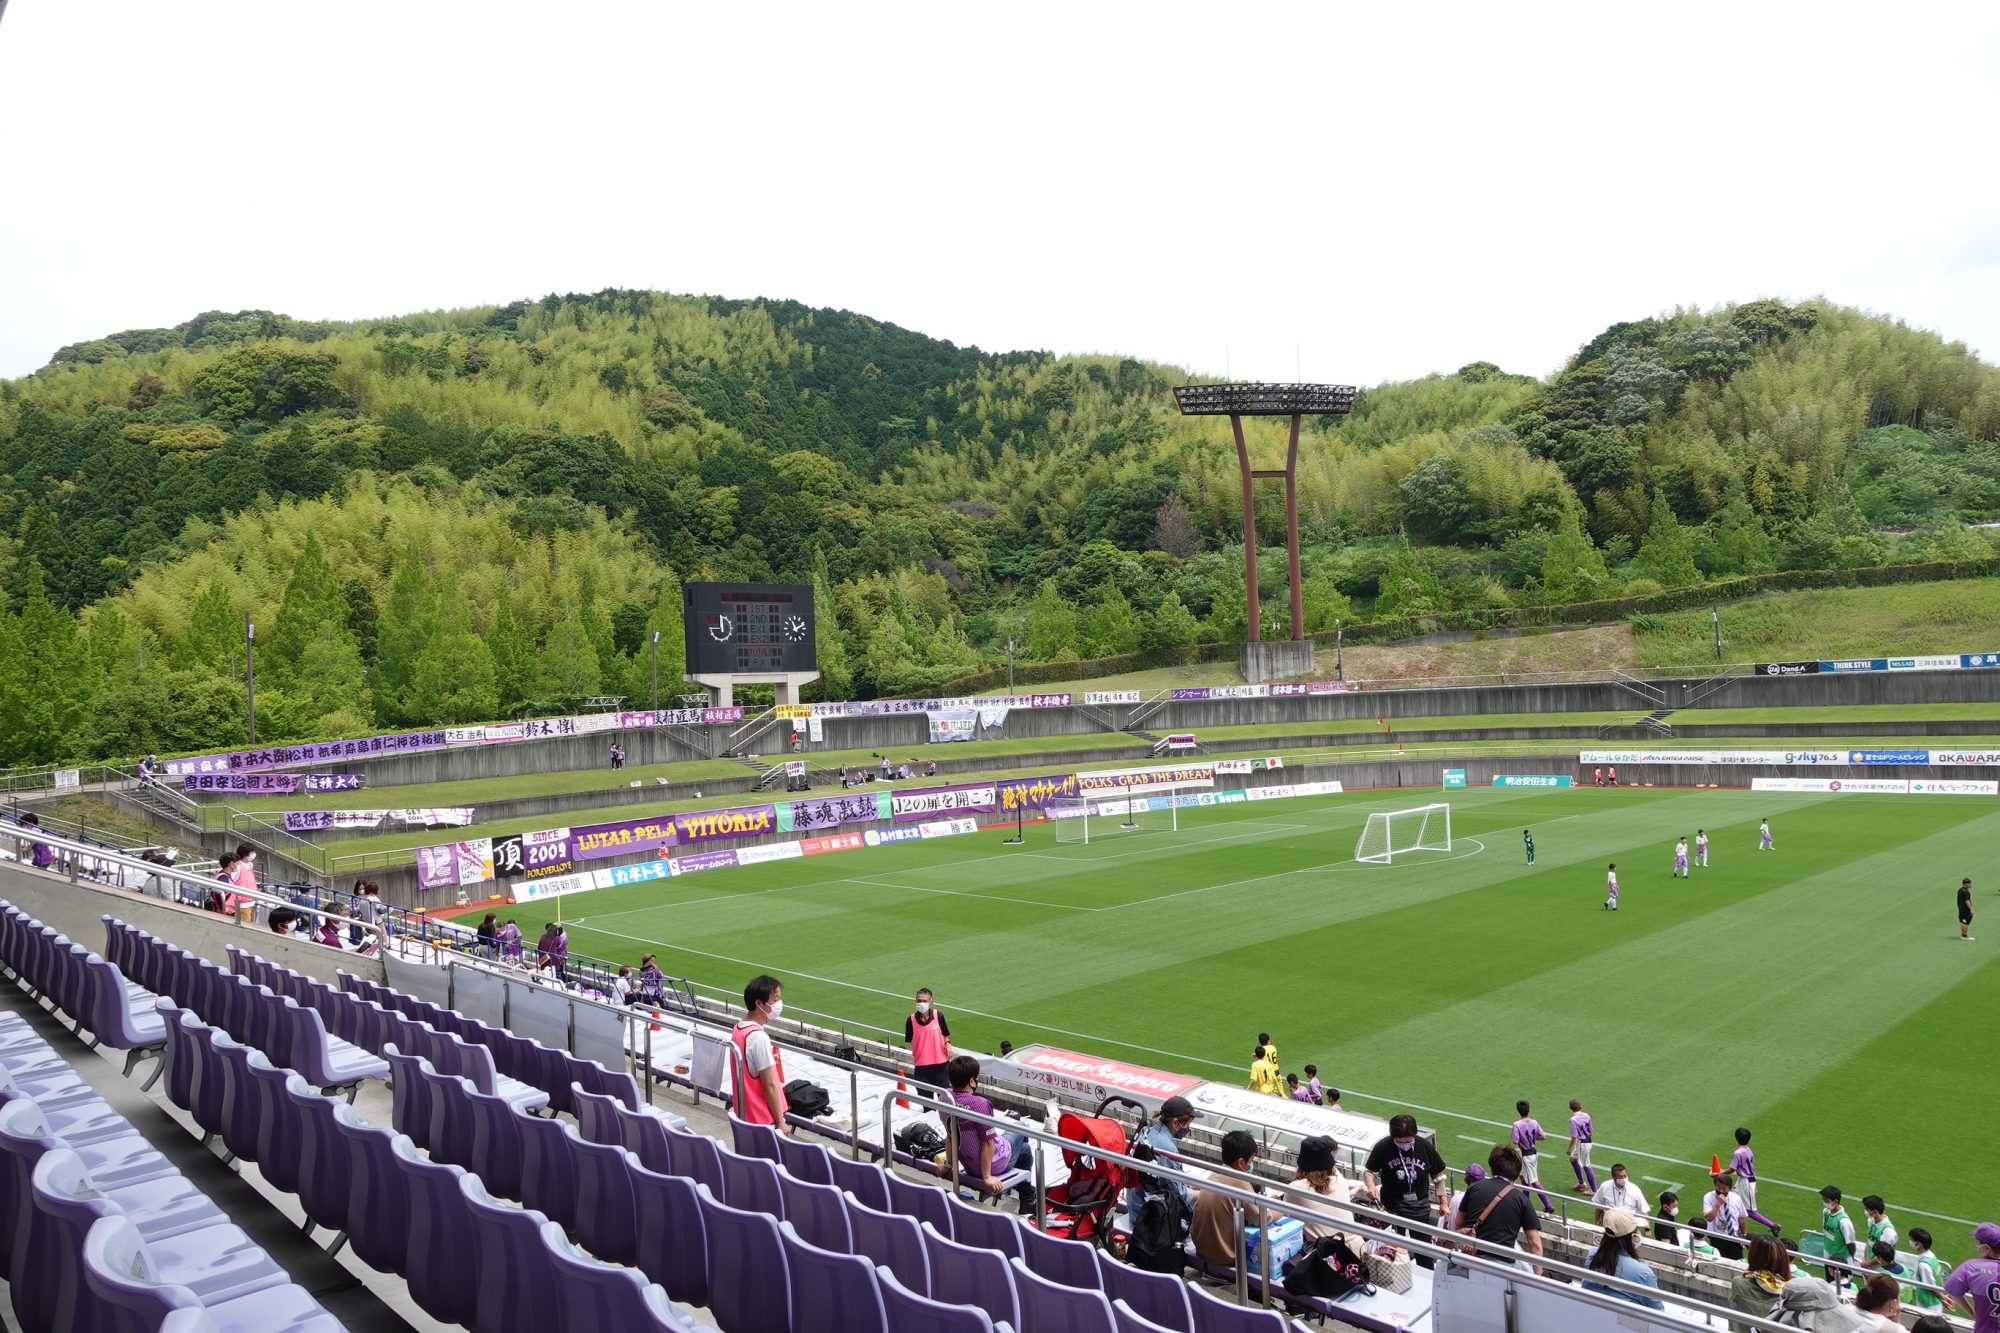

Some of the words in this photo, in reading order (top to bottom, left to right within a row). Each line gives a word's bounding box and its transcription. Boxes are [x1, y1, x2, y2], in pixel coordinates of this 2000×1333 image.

[751, 604, 765, 614] 1ST
[750, 614, 766, 623] 2ND
[750, 635, 768, 643] EX2
[748, 648, 770, 657] TOTAL
[1833, 661, 1853, 669] THINK
[1172, 690, 1208, 699] シジマール
[447, 730, 464, 740] 大石
[525, 720, 554, 738] 鈴木
[344, 736, 394, 754] 森島康仁
[1819, 753, 1838, 761] 76.5
[1118, 774, 1149, 786] GRAB
[1149, 772, 1173, 783] THE
[1175, 768, 1212, 781] DREAM
[1505, 776, 1557, 786] 明治安田生命
[1927, 783, 1994, 792] 住友ベークライト
[895, 789, 994, 814] J2の扉を開こう
[682, 809, 770, 838] VITÓRIA
[532, 830, 560, 843] SINCE
[577, 828, 633, 851] LUTAR
[633, 821, 677, 842] PELA
[830, 836, 860, 849] 富士屋
[493, 837, 525, 871] 頂
[529, 842, 567, 865] 2009
[780, 847, 800, 857] Group
[421, 846, 452, 879] 12
[615, 863, 666, 884] カネトモ
[538, 877, 582, 896] 静岡新聞
[1016, 1067, 1092, 1095] フェンス乗り出し禁止
[1226, 1100, 1369, 1142] しずおか焼津信用金庫
[1388, 1156, 1426, 1171] FOOBALL
